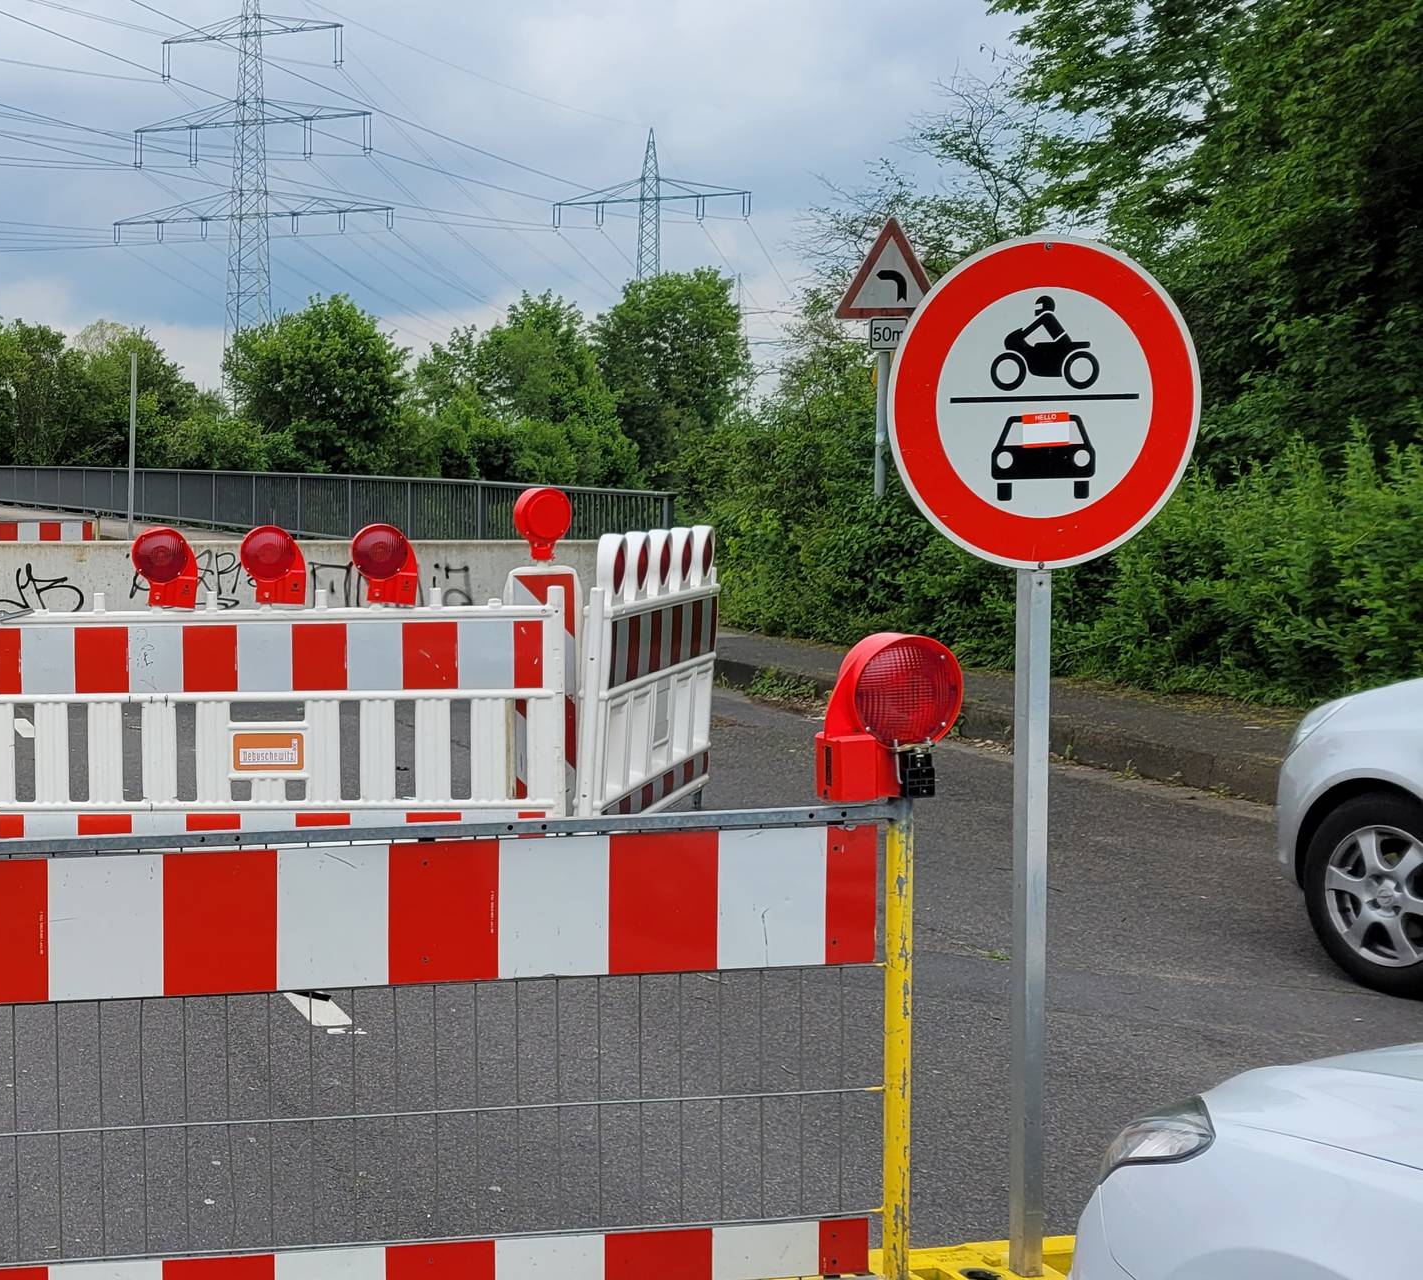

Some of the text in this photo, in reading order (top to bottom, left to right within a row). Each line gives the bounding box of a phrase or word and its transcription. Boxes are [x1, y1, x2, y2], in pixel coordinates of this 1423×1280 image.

[873, 326, 903, 342] 50m
[1035, 413, 1057, 421] HELLO
[242, 750, 294, 761] Debuschewitz
